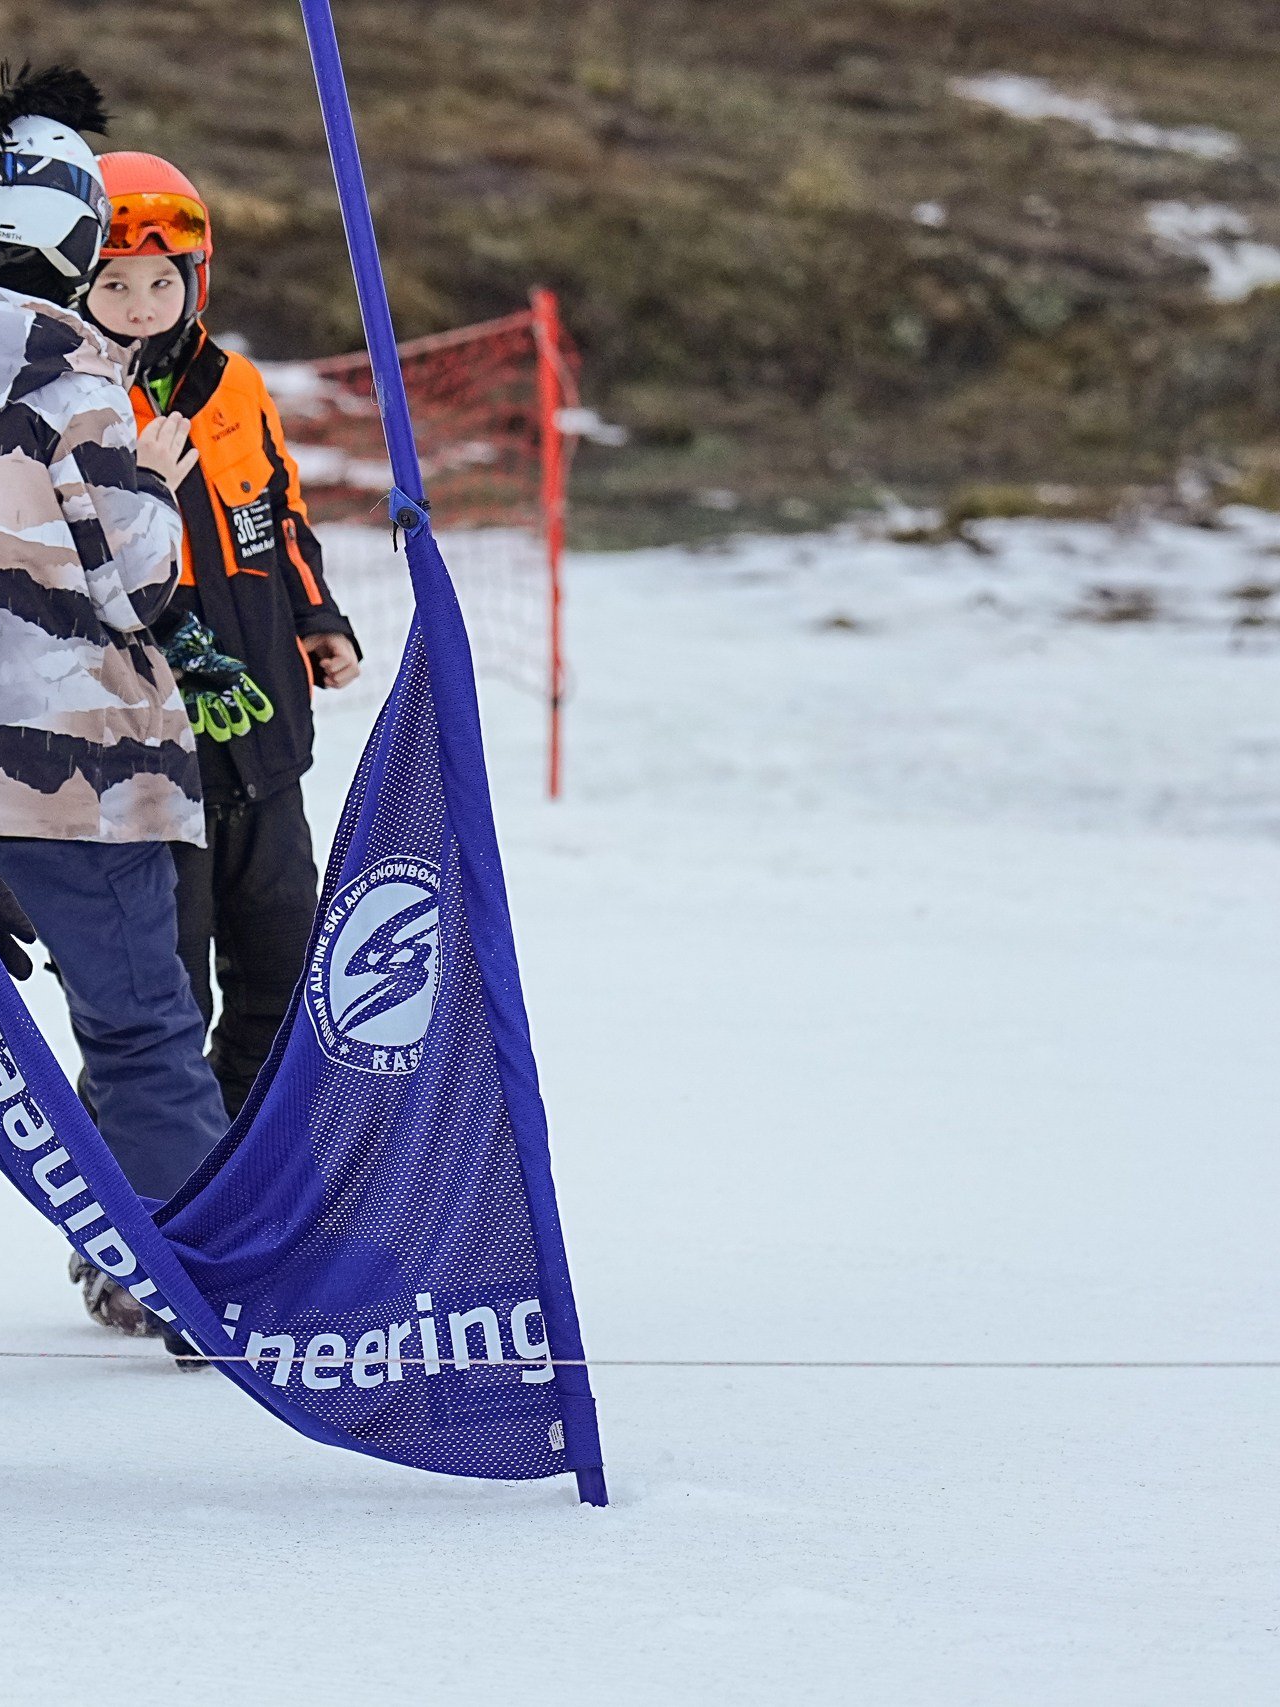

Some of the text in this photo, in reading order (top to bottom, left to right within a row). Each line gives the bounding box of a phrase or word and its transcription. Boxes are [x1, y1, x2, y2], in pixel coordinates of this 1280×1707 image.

[344, 881, 369, 908] AND
[324, 906, 346, 934] SKI
[310, 935, 329, 993] ALPINE
[313, 997, 336, 1049] RUSSIAN
[372, 1042, 424, 1072] RAS
